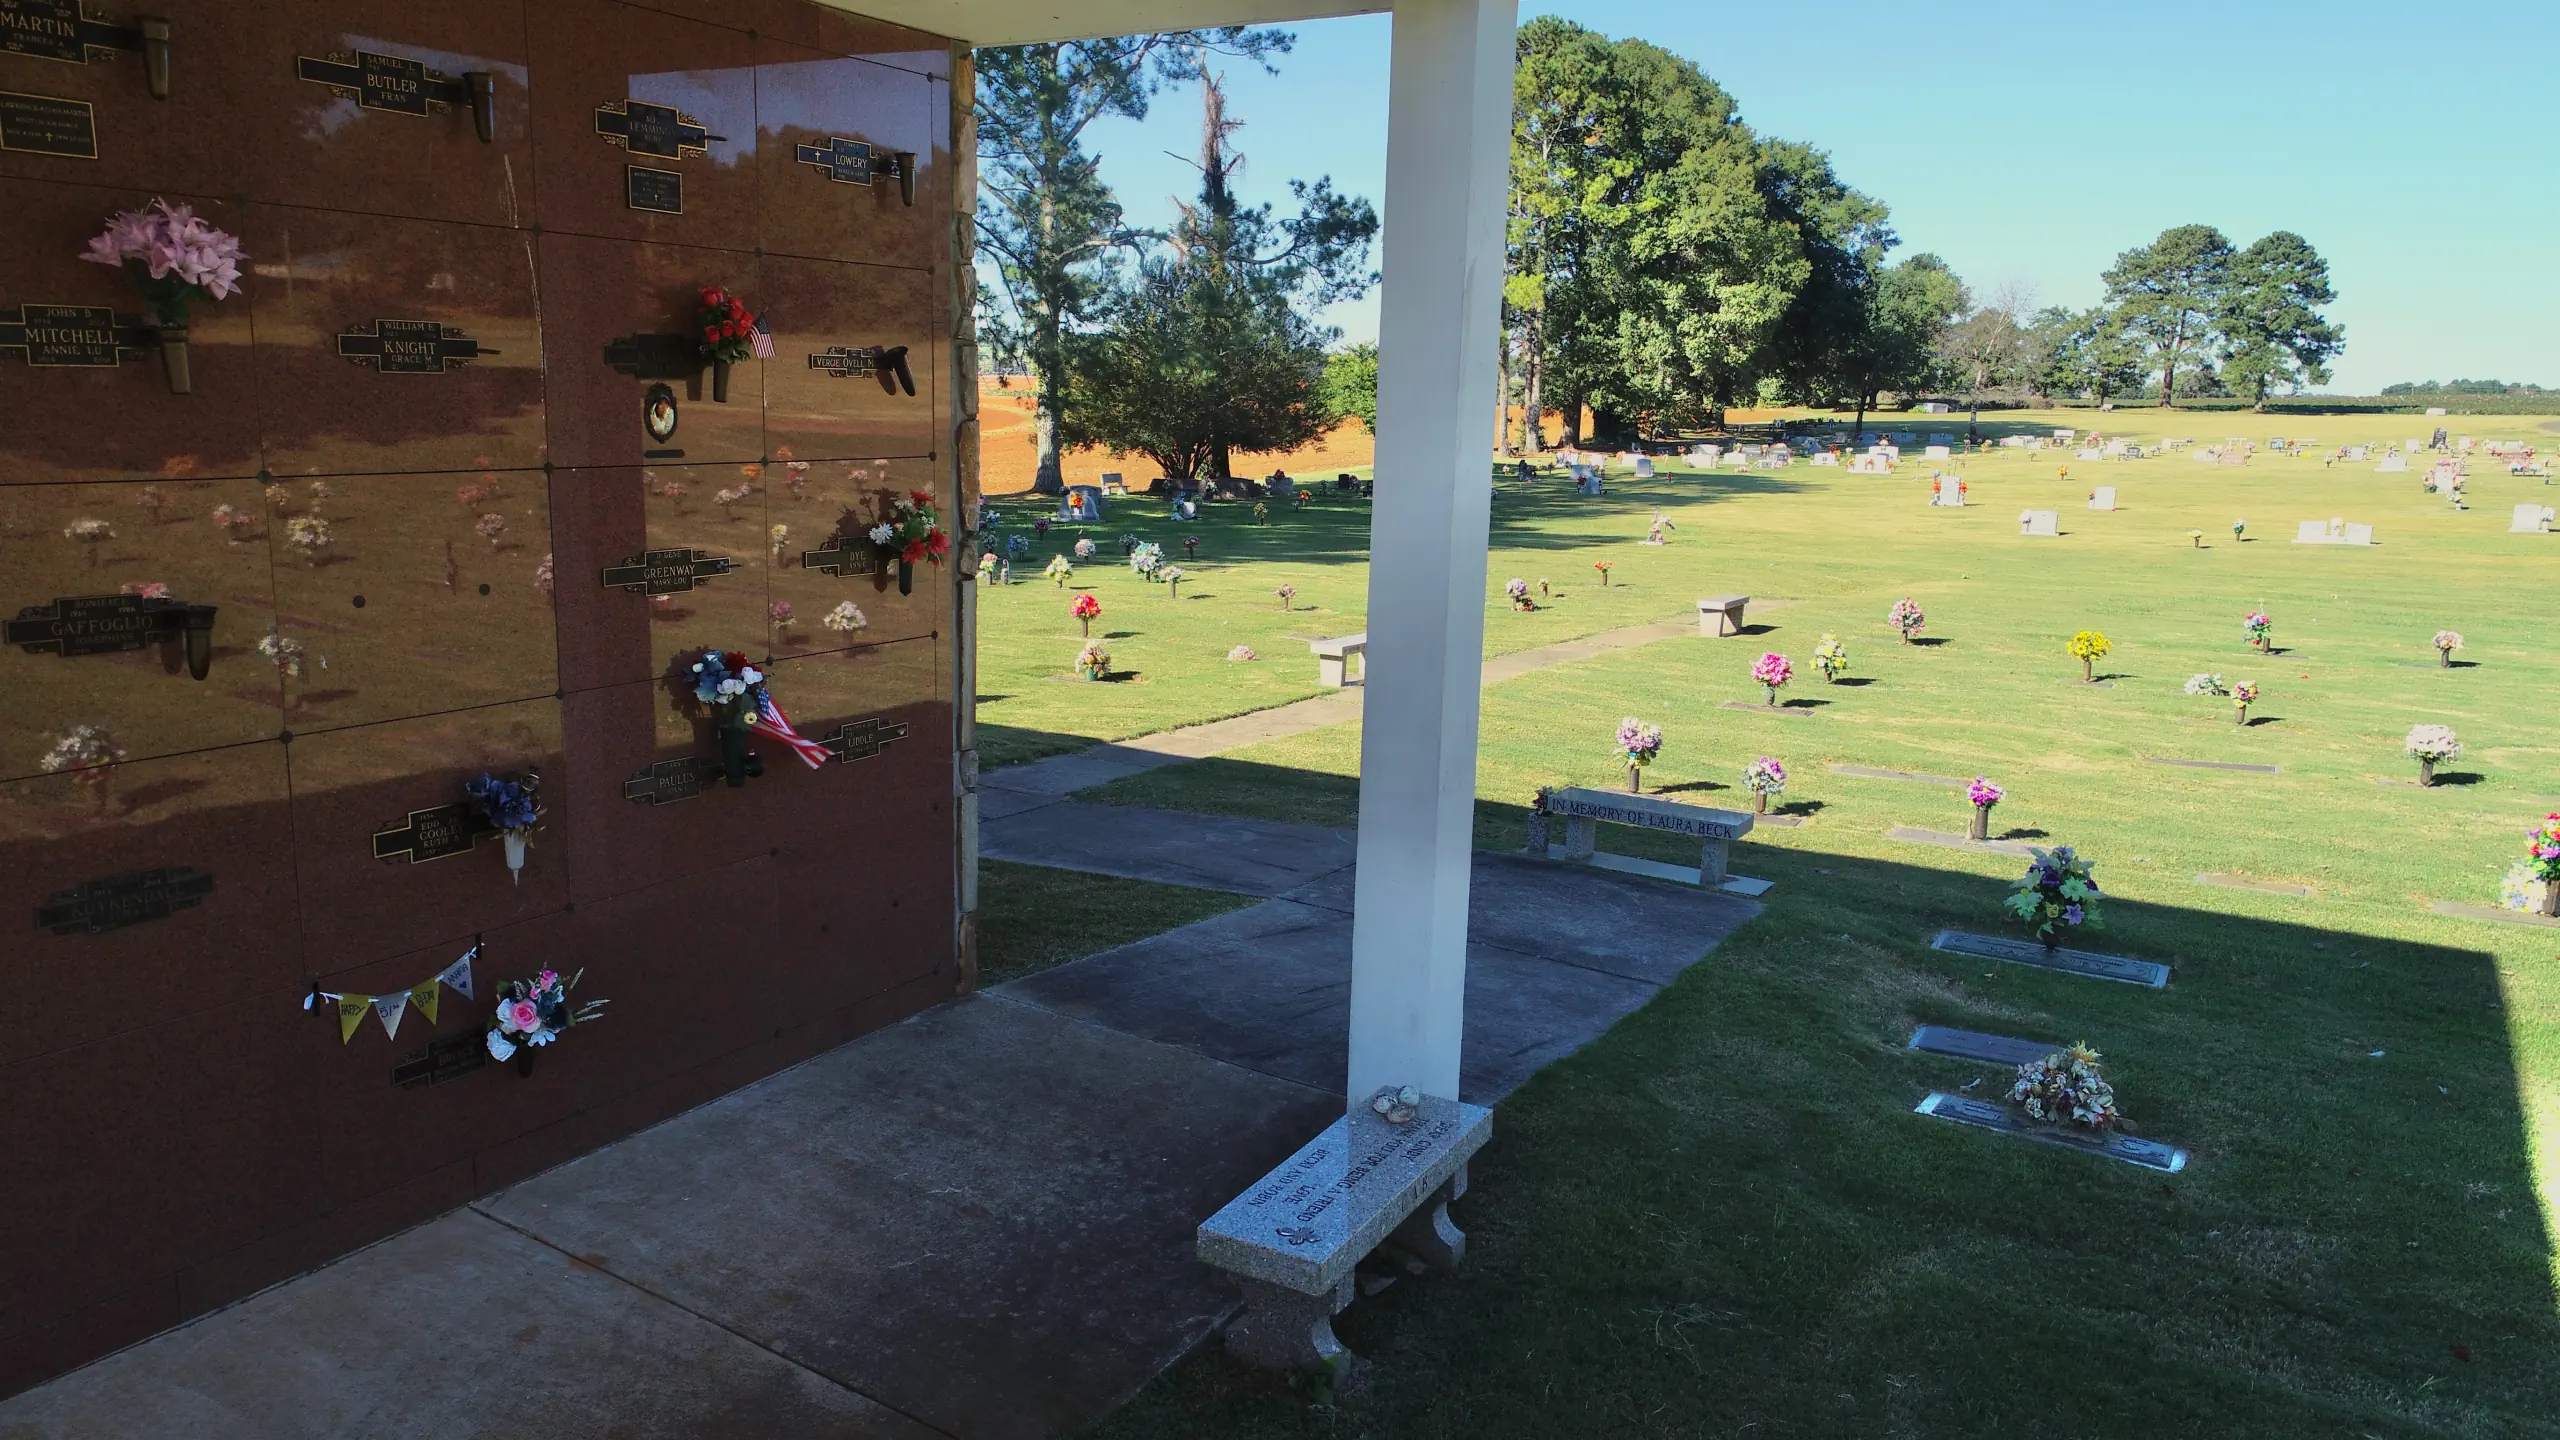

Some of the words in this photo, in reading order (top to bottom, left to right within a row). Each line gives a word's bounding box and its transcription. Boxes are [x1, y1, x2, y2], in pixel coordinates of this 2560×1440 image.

[0, 11, 75, 38] MARTIN
[367, 55, 404, 69] SAMUEL
[367, 73, 418, 94] BUTLER
[381, 91, 406, 103] FRAN
[835, 154, 868, 169] LOWERY
[46, 308, 76, 318] JOHN
[84, 309, 92, 318] B
[384, 321, 424, 331] WILLIAM
[25, 328, 120, 345] MITCHELL
[42, 345, 80, 355] ANNIE
[384, 340, 436, 355] KNIGHT
[391, 354, 422, 364] GRACE
[850, 551, 866, 561] DYE
[643, 564, 695, 579] GREENWAY
[653, 578, 670, 587] MARY
[673, 576, 687, 585] LOU
[51, 616, 153, 637] GAFFOGLIO
[848, 733, 874, 748] LIDDLE
[659, 772, 695, 788] PAULUS
[421, 820, 440, 831] EDD
[1552, 798, 1565, 811] IN
[1569, 800, 1623, 820] MEMORY
[1628, 810, 1645, 824] OF
[1649, 814, 1693, 833] LAURA
[1698, 821, 1733, 839] BECK
[419, 824, 464, 841] COOLEY
[424, 836, 449, 849] RUTH
[341, 1004, 365, 1017] HAPPY
[1381, 1138, 1405, 1153] YOU
[1400, 1140, 1432, 1160] CINDY
[1300, 1149, 1330, 1169] BECKI
[1361, 1151, 1387, 1167] FOR
[1279, 1168, 1302, 1184] AND
[1337, 1167, 1370, 1188] BEING
[1248, 1184, 1283, 1208] ROBIN
[1297, 1195, 1335, 1221] FRIEND
